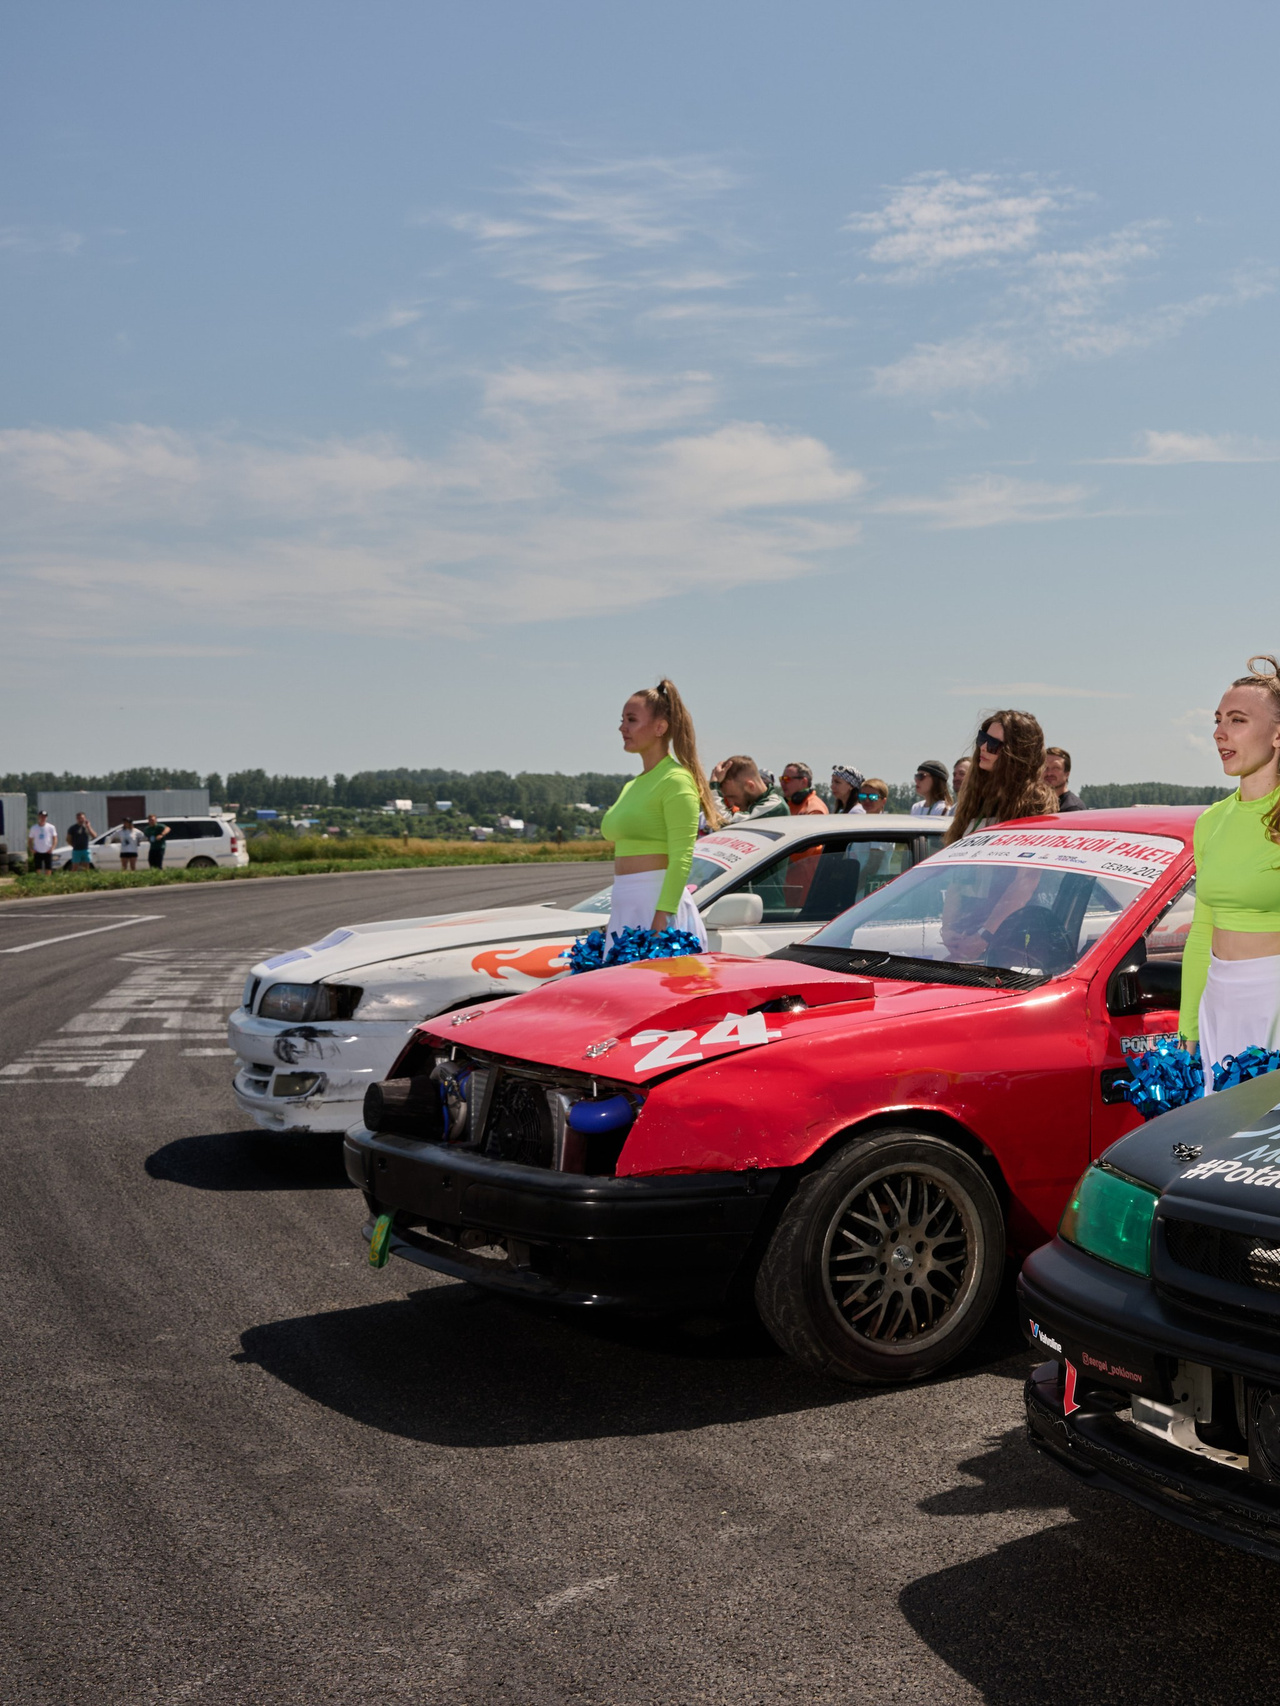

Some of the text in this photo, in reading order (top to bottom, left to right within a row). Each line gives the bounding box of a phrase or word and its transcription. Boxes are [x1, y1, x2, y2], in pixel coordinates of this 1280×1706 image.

[988, 834, 1116, 854] БАРНАУЛЬСКОЙ
[1101, 862, 1163, 879] СЕЗОН 202
[631, 1011, 782, 1072] 24
[1039, 1330, 1062, 1353] Valvoline
